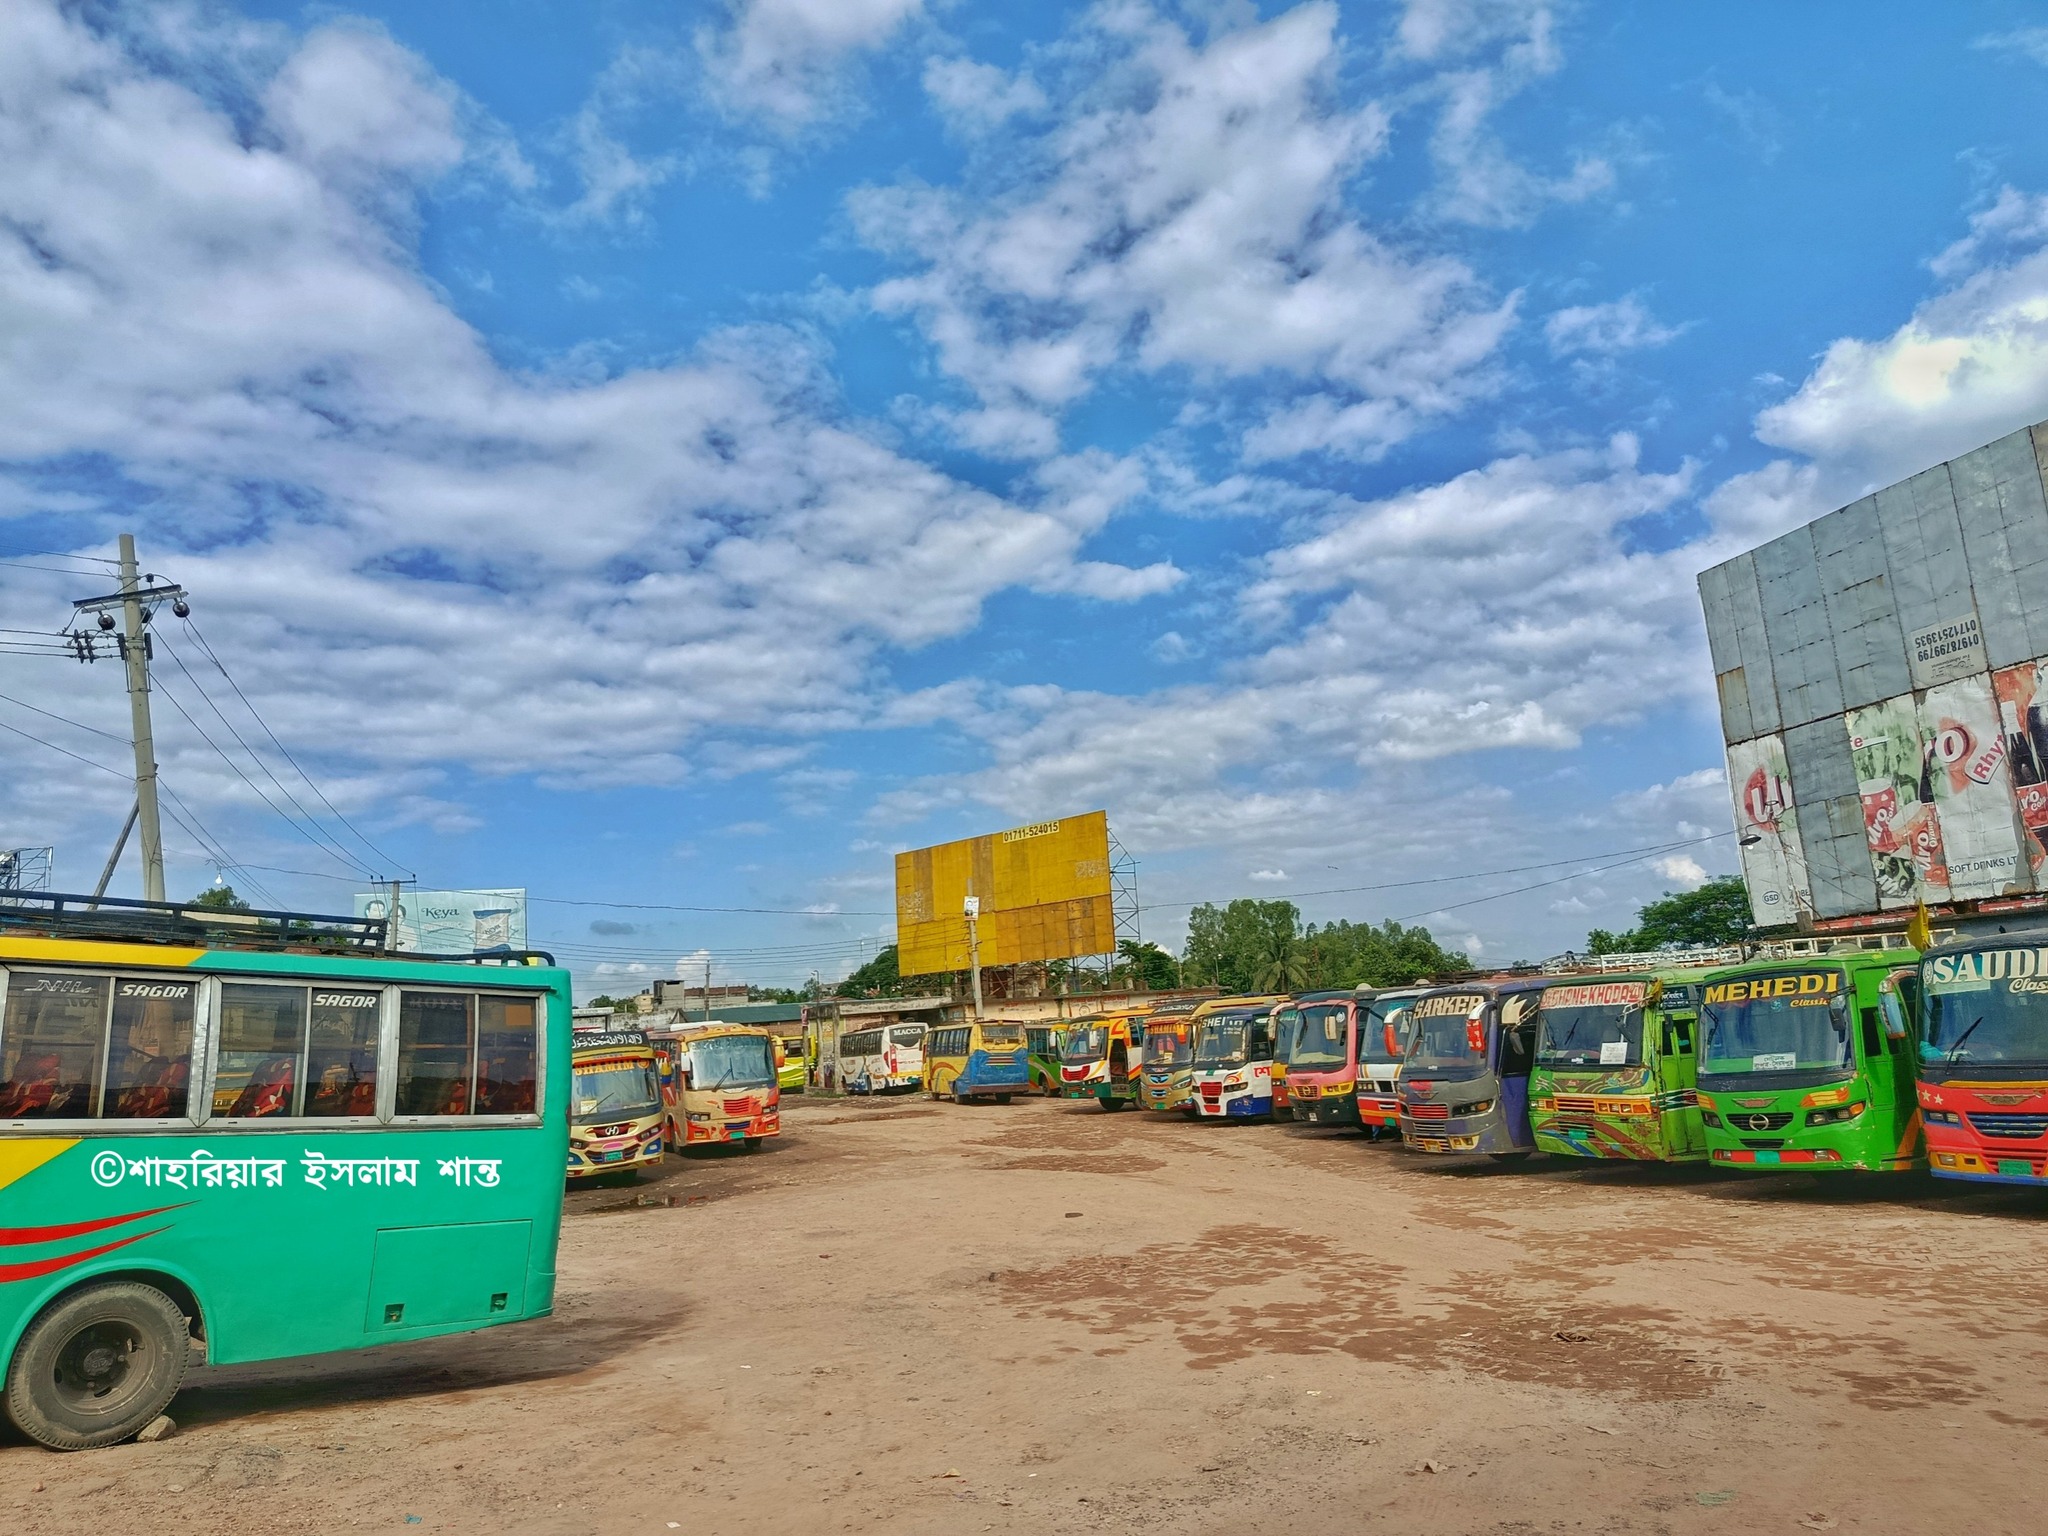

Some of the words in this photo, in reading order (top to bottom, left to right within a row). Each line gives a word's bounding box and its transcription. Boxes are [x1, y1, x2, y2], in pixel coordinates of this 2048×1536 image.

[1914, 619, 1977, 648] 01712513935
[1917, 634, 1980, 663] 01978799799
[1003, 822, 1059, 842] 01711-524015
[1948, 863, 1971, 875] SOFT
[1800, 889, 1810, 897] BE
[421, 907, 459, 919] Keya
[1933, 949, 2048, 985] SAUDI
[119, 984, 189, 999] SAGOR
[1704, 973, 1839, 1005] MEHEDI
[313, 994, 377, 1008] SAGOR
[893, 1028, 922, 1036] MACCA
